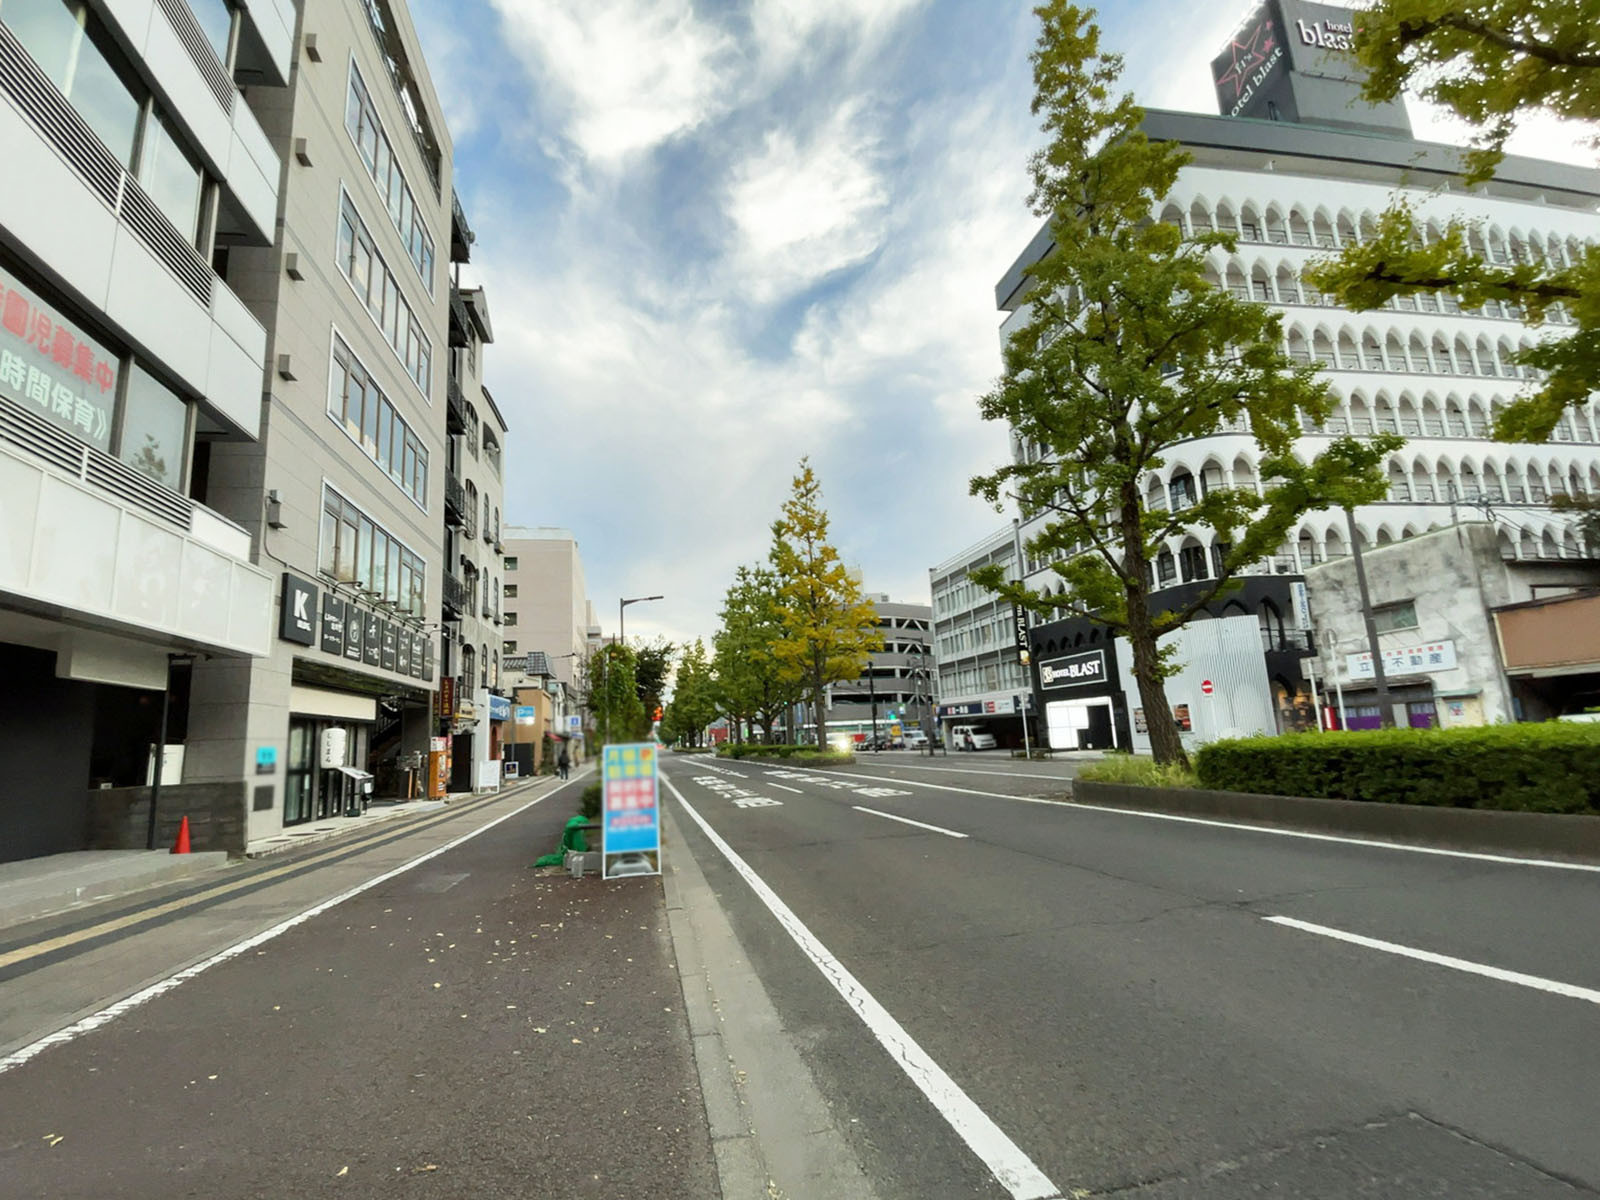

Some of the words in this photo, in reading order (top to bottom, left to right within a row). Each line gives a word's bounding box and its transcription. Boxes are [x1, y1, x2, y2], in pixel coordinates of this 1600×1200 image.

[1325, 19, 1353, 34] hotel
[1231, 84, 1253, 117] otel
[1252, 47, 1283, 87] blast
[293, 589, 309, 621] K
[1016, 617, 1028, 648] BLAST
[1069, 660, 1101, 678] BLAST
[1359, 653, 1443, 672] 立不動産
